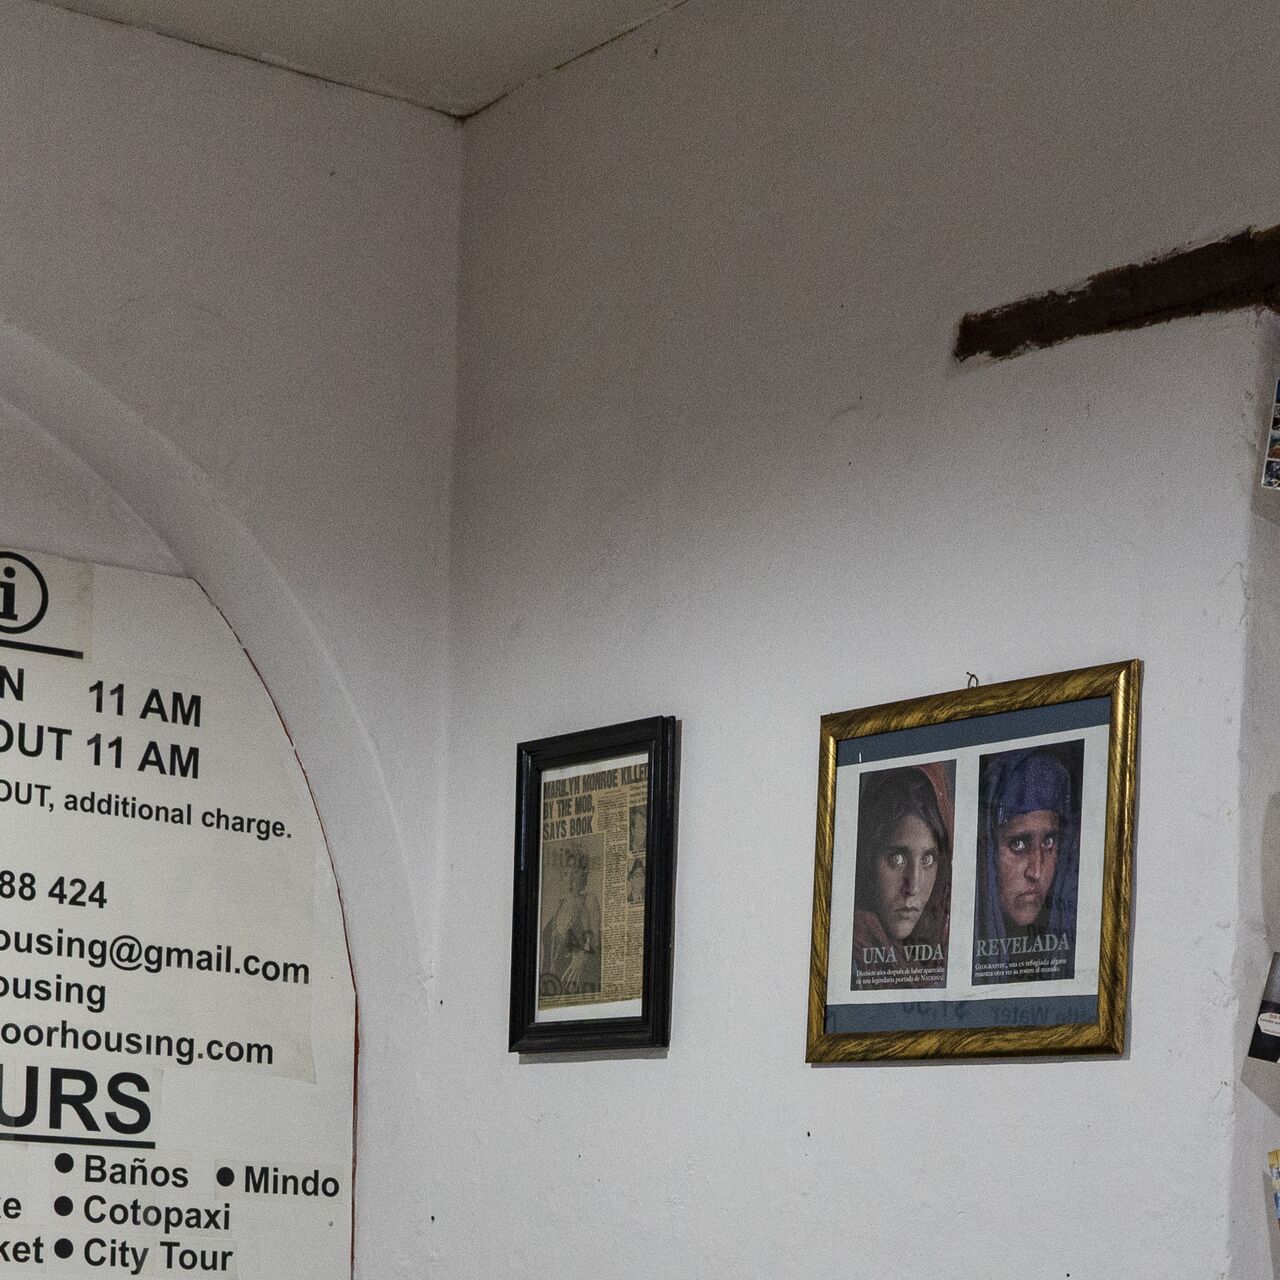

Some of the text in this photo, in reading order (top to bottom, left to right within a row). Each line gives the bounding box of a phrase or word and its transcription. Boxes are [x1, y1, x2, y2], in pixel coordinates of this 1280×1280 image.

[88, 679, 125, 717] 11
[139, 687, 202, 728] AM
[86, 732, 123, 769] 11
[137, 740, 200, 780] AM
[63, 791, 192, 826] additional
[201, 807, 292, 842] charge.
[47, 875, 108, 910] 424
[862, 943, 944, 964] UNA VIDA
[976, 932, 1069, 957] REVELADA
[84, 1153, 189, 1189] Baños
[244, 1165, 340, 1198] Mindo
[83, 1194, 231, 1235] Cotopaxi
[83, 1237, 150, 1276] City
[159, 1240, 234, 1272] Tour
